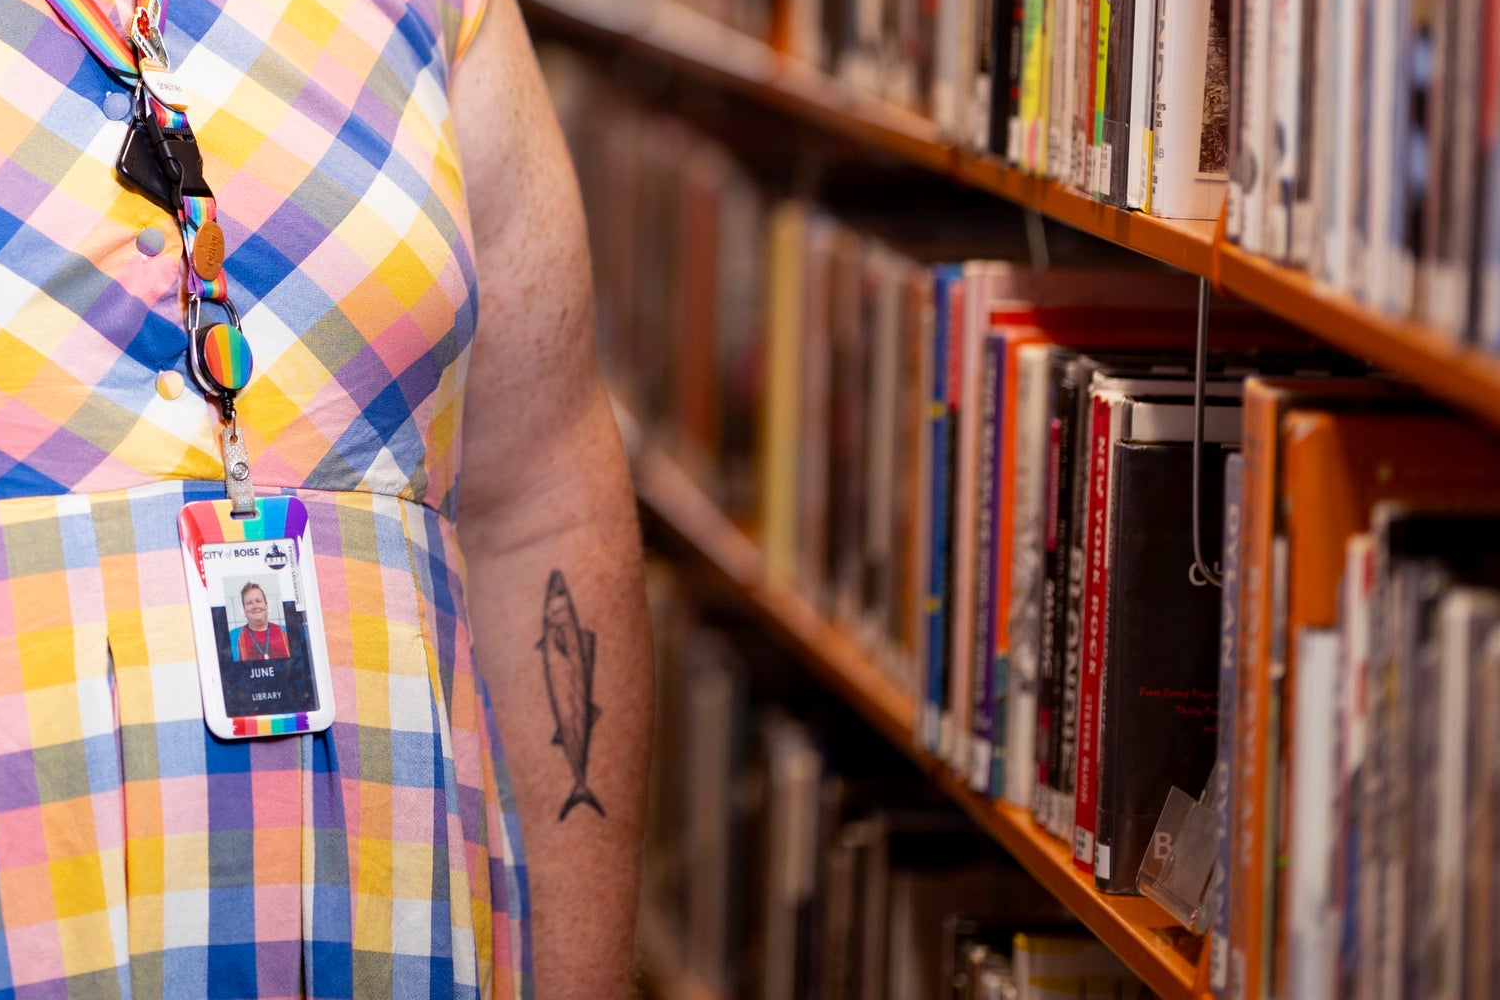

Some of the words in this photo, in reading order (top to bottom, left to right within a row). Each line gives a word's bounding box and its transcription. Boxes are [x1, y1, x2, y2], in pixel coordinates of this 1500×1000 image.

[1095, 436, 1106, 498] NEW
[203, 550, 223, 560] CITY
[234, 548, 260, 558] BOISE
[1091, 509, 1103, 584] YORK
[1222, 503, 1240, 668] DYLAN
[1087, 596, 1100, 676] ROCK
[250, 666, 275, 679] JUNE
[251, 691, 282, 702] LIBRARY
[1213, 761, 1230, 926] DYLAN
